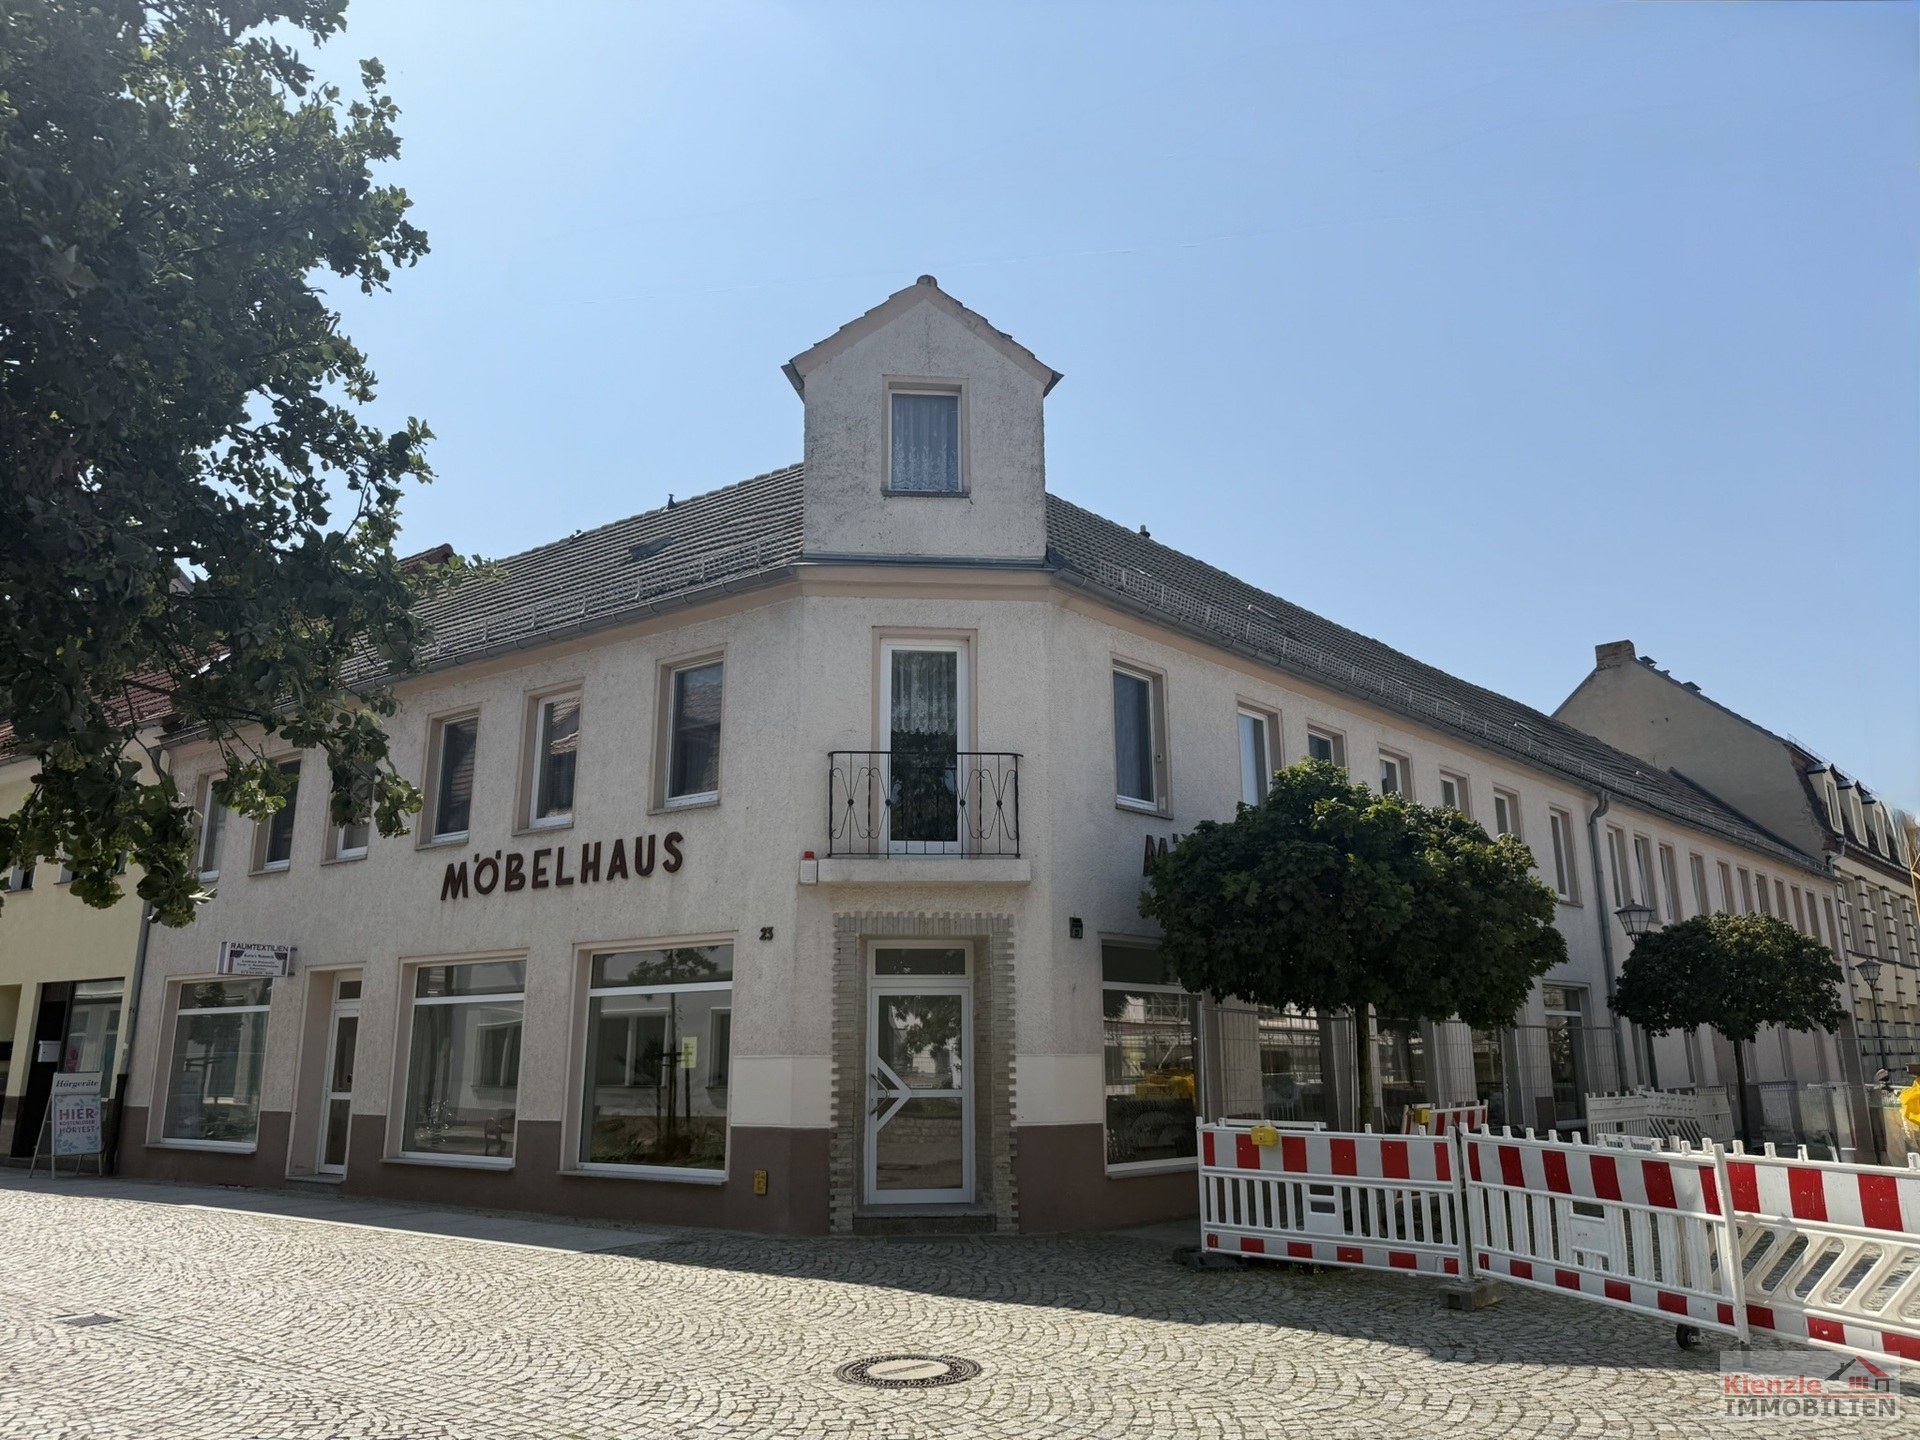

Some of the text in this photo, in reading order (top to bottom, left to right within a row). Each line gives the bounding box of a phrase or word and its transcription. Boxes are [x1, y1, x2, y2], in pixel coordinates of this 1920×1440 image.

[440, 831, 684, 901] MÖBELHAUS
[230, 943, 289, 952] RAUMTEXTILIEN
[56, 1079, 99, 1089] Hörgeräte
[59, 1108, 95, 1120] HIER
[59, 1126, 95, 1134] HÖRTEST
